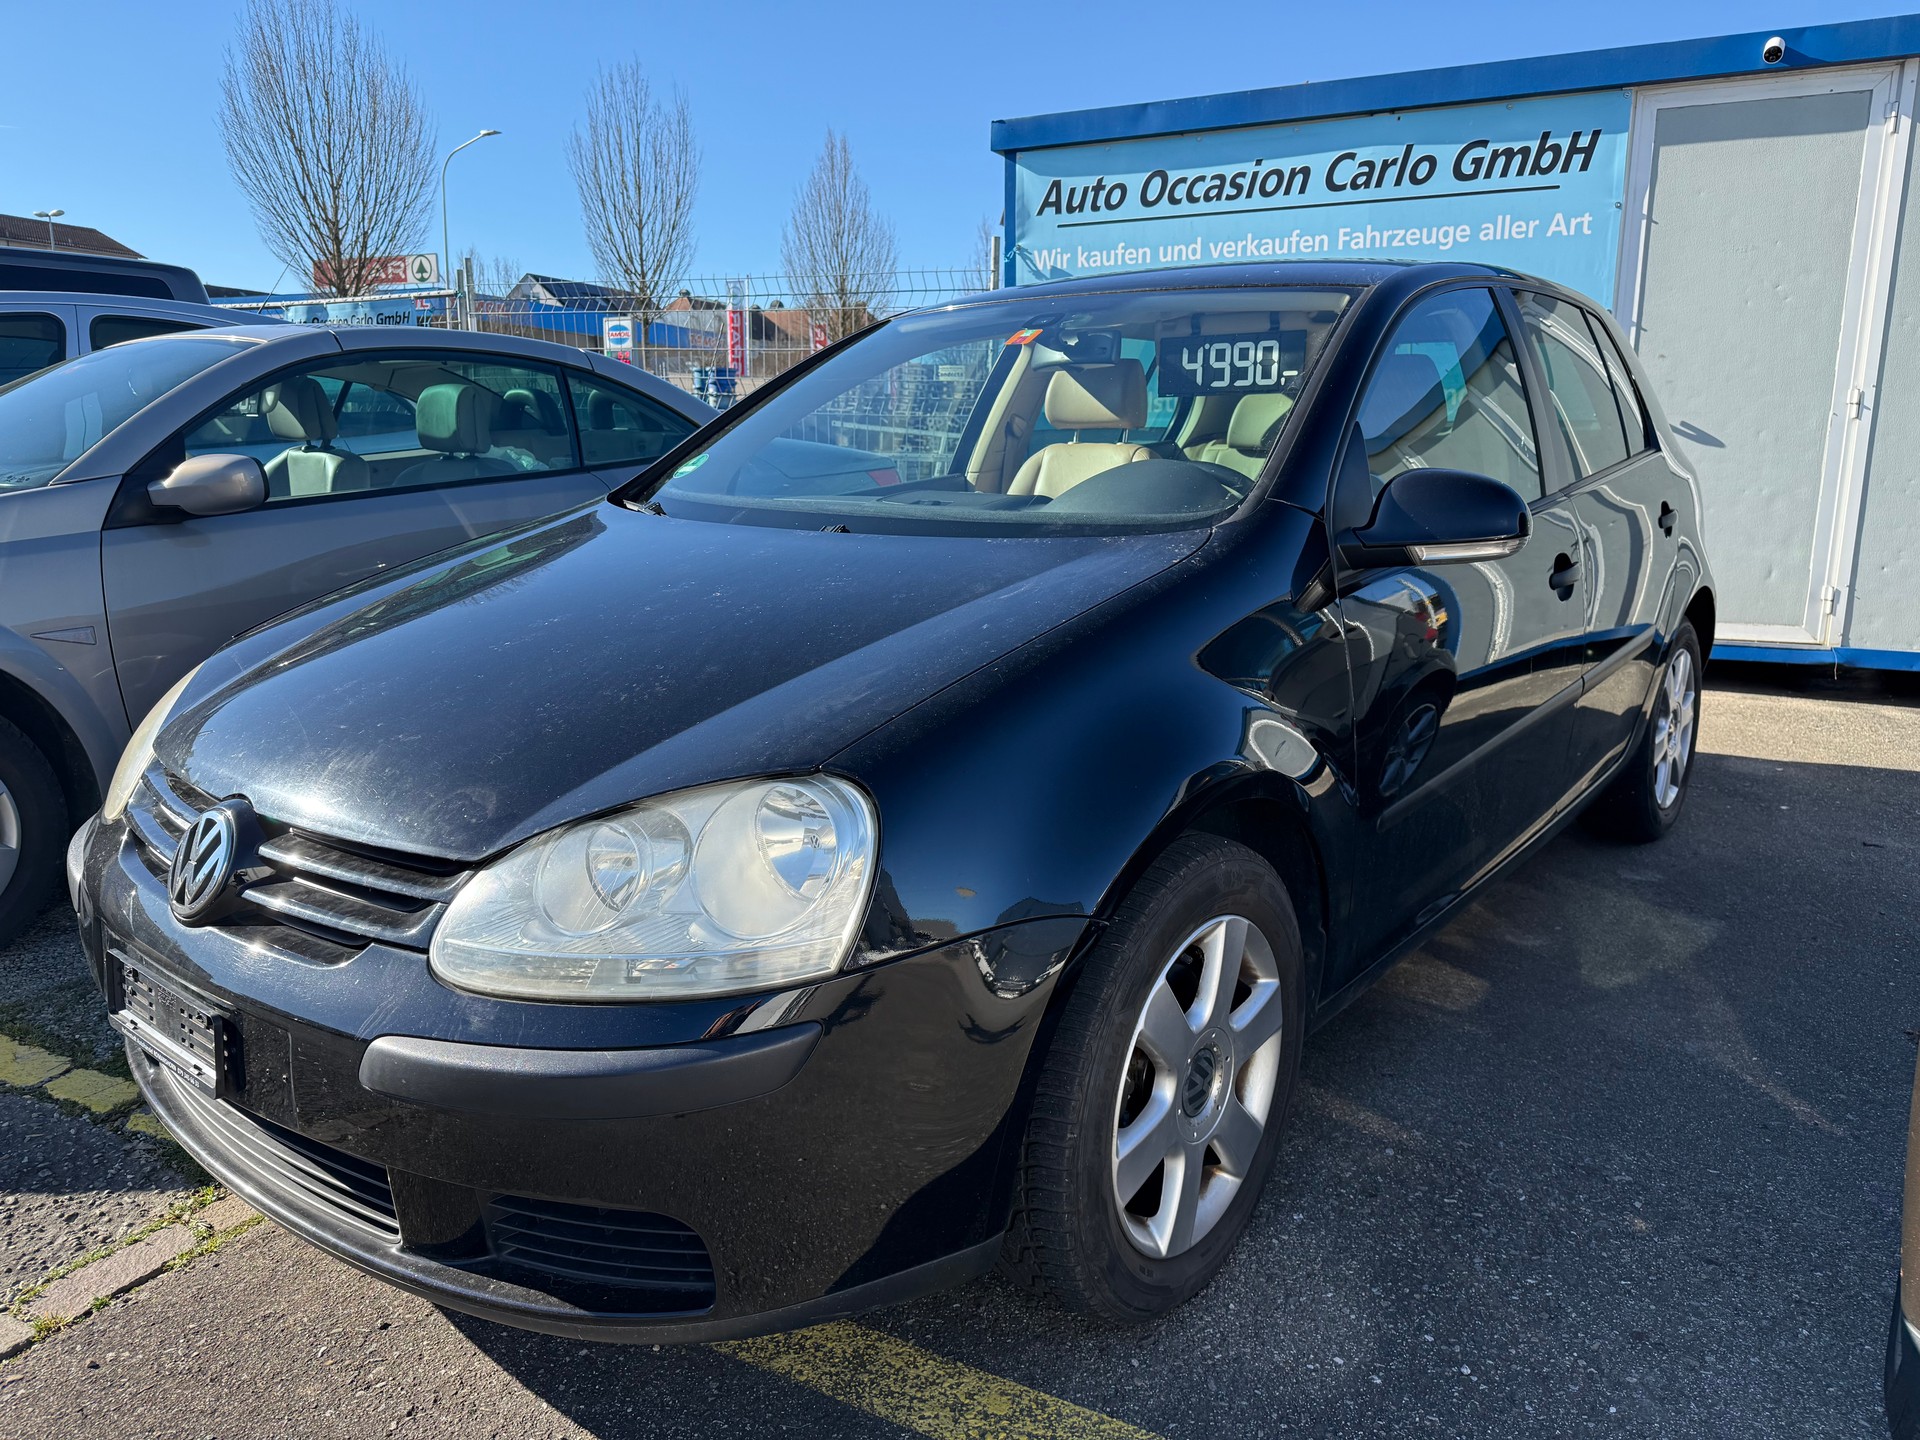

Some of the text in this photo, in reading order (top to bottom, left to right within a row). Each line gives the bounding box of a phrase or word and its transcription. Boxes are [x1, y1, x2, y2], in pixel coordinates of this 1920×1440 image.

[1036, 128, 1603, 217] Auto Occasion Carlo GmbH
[1033, 212, 1593, 271] Wir kaufen und verkaufen Fahrzeuge aller Art
[376, 310, 411, 325] GmbH
